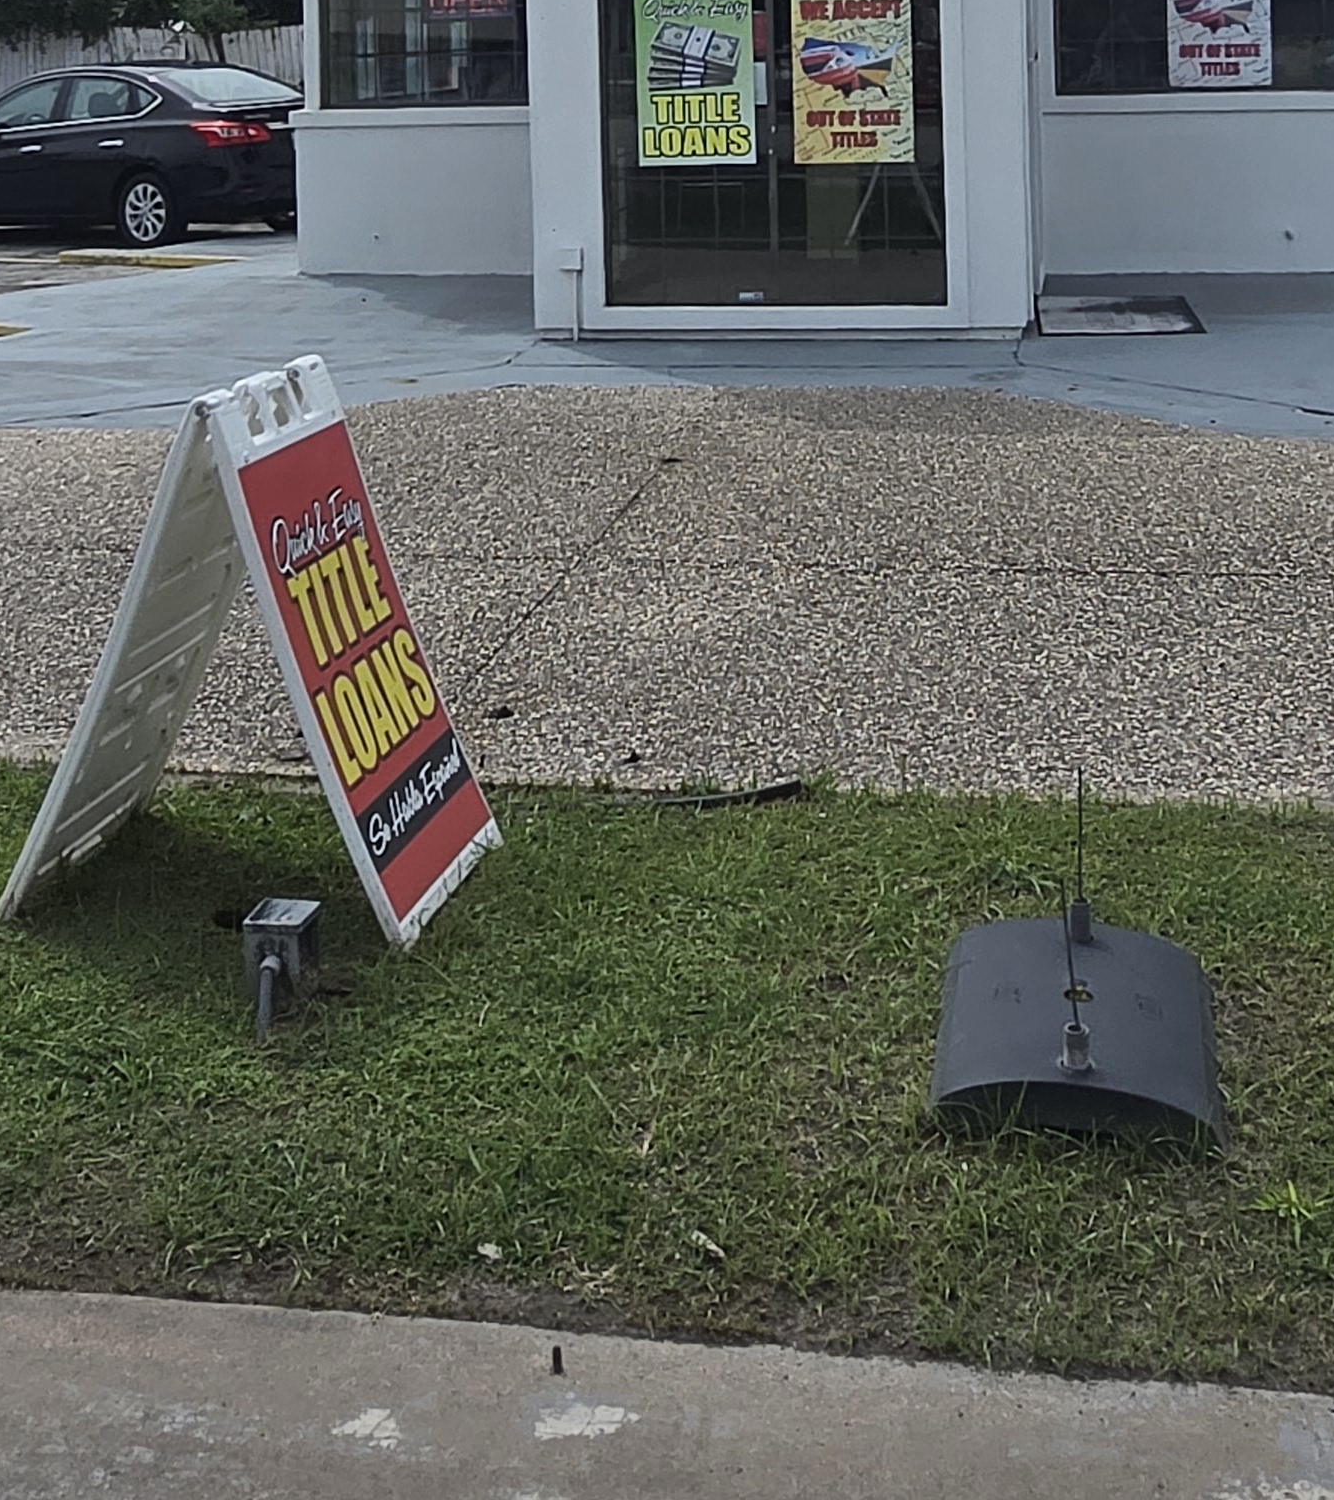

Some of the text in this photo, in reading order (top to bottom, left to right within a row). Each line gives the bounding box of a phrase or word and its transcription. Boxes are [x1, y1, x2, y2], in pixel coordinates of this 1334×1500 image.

[799, 0, 829, 20] WE
[1179, 44, 1263, 58] OUT OF STATE
[1199, 62, 1240, 76] TITLES
[650, 92, 741, 124] TITLE
[806, 109, 901, 127] OUT OF STATE
[643, 125, 752, 158] LOANS
[830, 132, 878, 148] TITLES
[272, 512, 322, 579] Quick
[286, 533, 392, 668] TITLE
[314, 627, 436, 788] LOANS
[369, 812, 391, 856] Se
